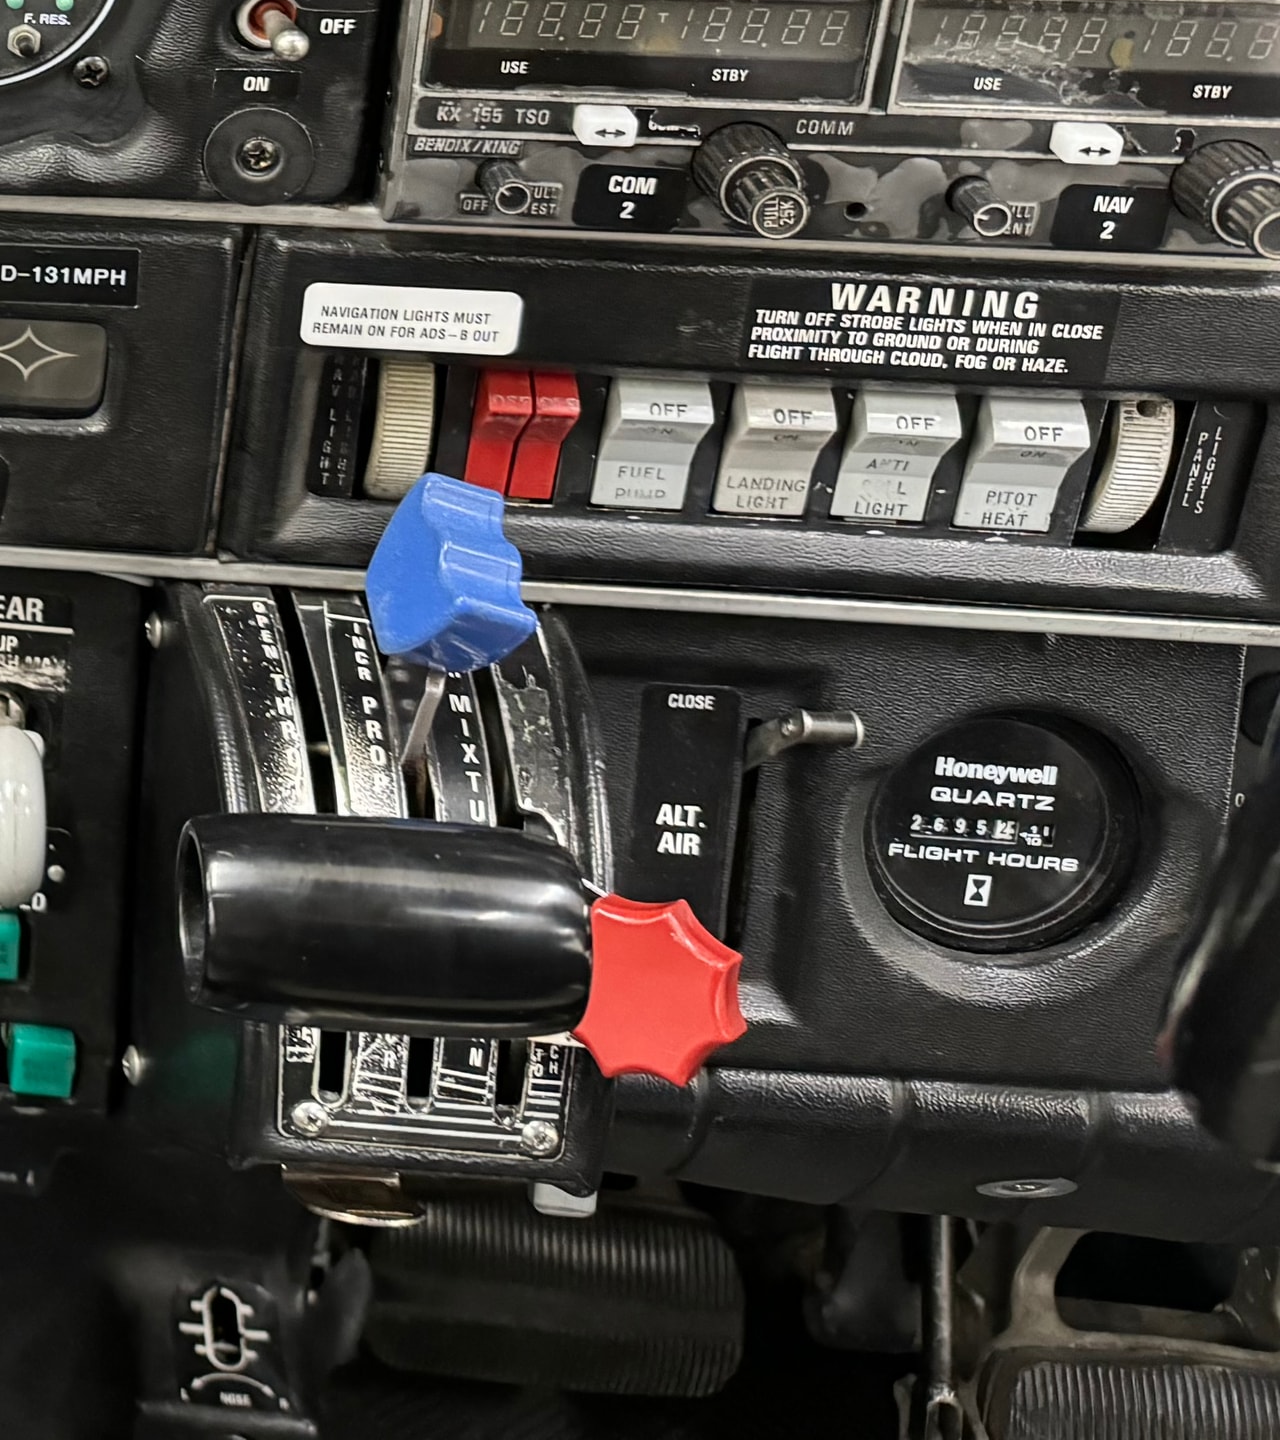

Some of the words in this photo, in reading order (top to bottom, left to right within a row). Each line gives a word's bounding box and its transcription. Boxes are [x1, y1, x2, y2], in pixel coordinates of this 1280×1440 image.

[319, 19, 356, 35] OFF
[499, 59, 530, 75] USE
[711, 66, 750, 84] STBY
[243, 77, 270, 92] ON
[607, 173, 658, 198] COM
[620, 200, 636, 221] 2
[1092, 193, 1135, 215] NAV
[1100, 220, 1117, 240] 2
[830, 282, 1040, 320] WARNING
[321, 305, 399, 321] NAVIGATION
[403, 308, 449, 323] LIGHTS
[453, 312, 491, 325] MUST
[755, 309, 800, 326] TURN
[804, 311, 835, 328] OFF
[839, 313, 903, 331] STROBE
[910, 317, 966, 335] LIGHTS
[972, 320, 1022, 337] WHEN
[1028, 322, 1047, 338] IN
[1052, 323, 1104, 341] CLOSE
[312, 322, 363, 337] REMAIN
[367, 325, 385, 337] ON
[390, 326, 415, 339] FOR
[472, 330, 500, 343] OUT
[750, 326, 841, 345] PROXIMITY
[847, 330, 869, 346] TO
[872, 332, 941, 350] GROUND
[947, 336, 971, 352] OR
[975, 338, 1041, 355] DURING
[748, 343, 802, 361] FLIGHT
[808, 346, 886, 365] THROUGH
[954, 353, 987, 371] FOG
[992, 356, 1016, 372] OR
[1021, 357, 1069, 374] HAZE.
[773, 408, 813, 426] OFF
[1023, 426, 1064, 443] OFF
[985, 489, 1038, 508] PITOT
[981, 511, 1029, 528] HEAT
[667, 692, 716, 712] CLOSE
[934, 756, 1058, 787] Honeywell
[930, 785, 1056, 812] QUARTZ
[655, 803, 706, 829] ALT.
[657, 831, 701, 857] AIR
[888, 842, 981, 866] FLIGHT
[987, 848, 1079, 874] HOURS
